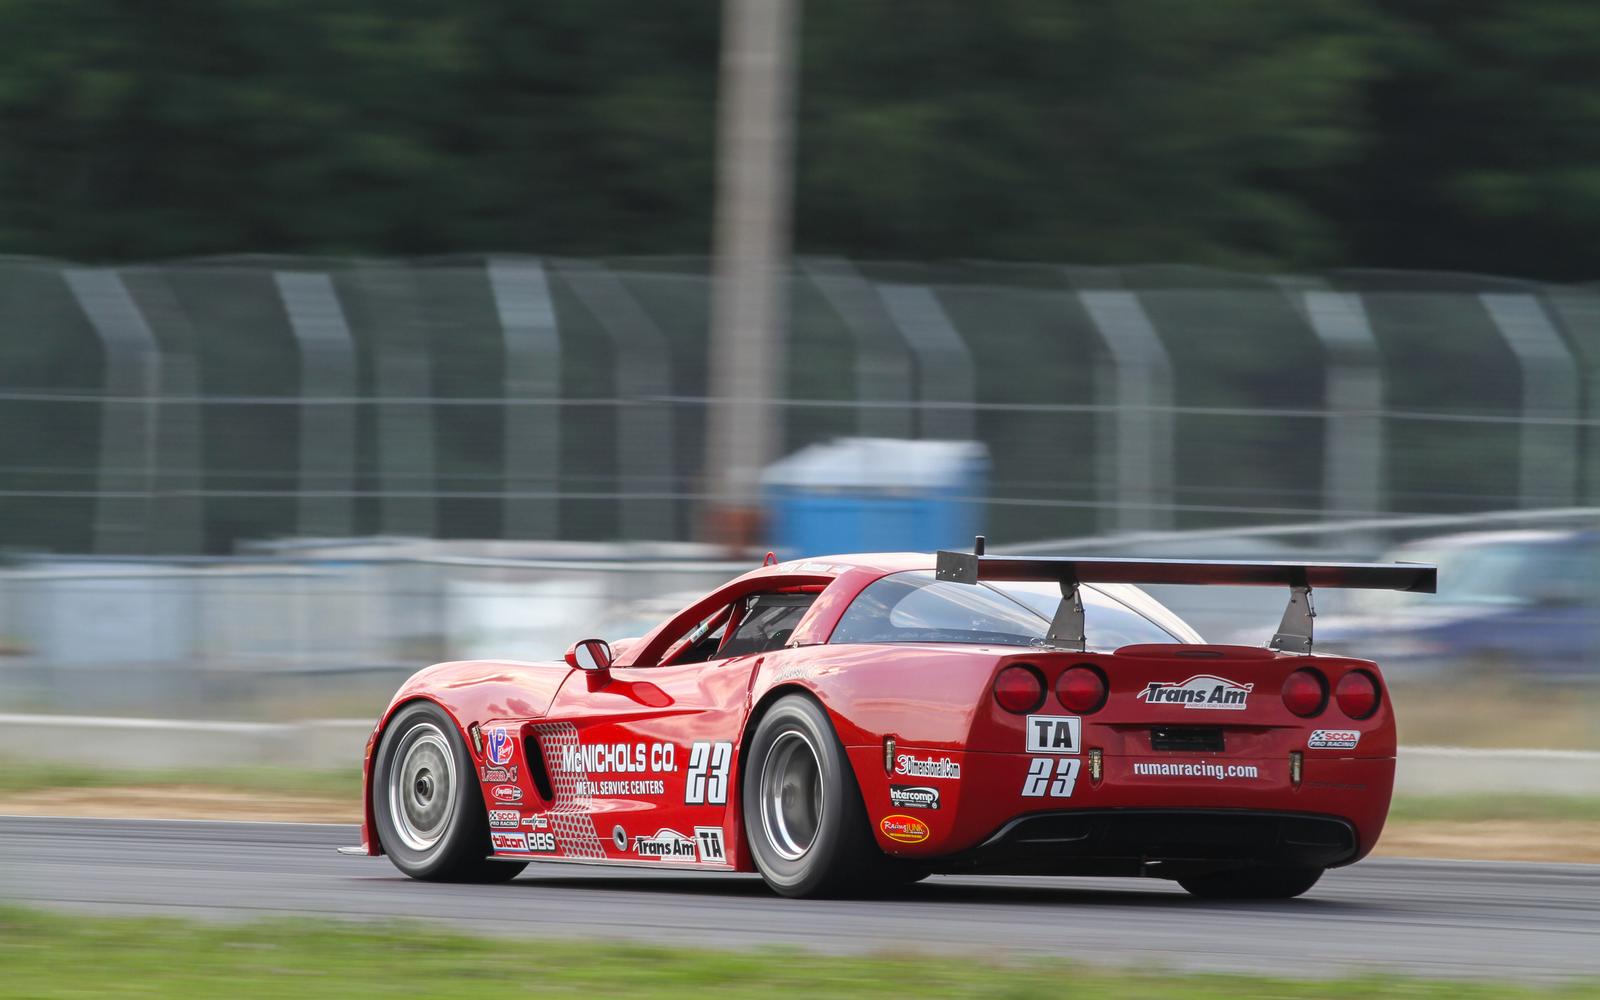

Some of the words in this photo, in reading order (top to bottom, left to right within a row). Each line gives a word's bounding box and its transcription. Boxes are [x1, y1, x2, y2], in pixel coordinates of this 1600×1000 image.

[1207, 685, 1246, 703] Am
[1034, 720, 1073, 748] TA
[1325, 732, 1356, 740] SCCA
[488, 728, 506, 763] VP
[563, 743, 647, 773] McNICHOLS
[651, 743, 678, 772] CO.
[685, 742, 733, 804] 23
[1021, 758, 1081, 798] 23
[1134, 761, 1258, 779] rumanracing.com
[576, 781, 599, 794] METAL
[600, 781, 630, 795] SERVICE
[630, 780, 664, 795] CENTERS
[890, 788, 933, 803] Intercomp
[497, 812, 518, 820] SCCA
[493, 835, 527, 849] tilton
[528, 832, 556, 850] BBS
[637, 837, 672, 855] Trans
[672, 838, 694, 855] Am
[699, 832, 723, 858] TA
